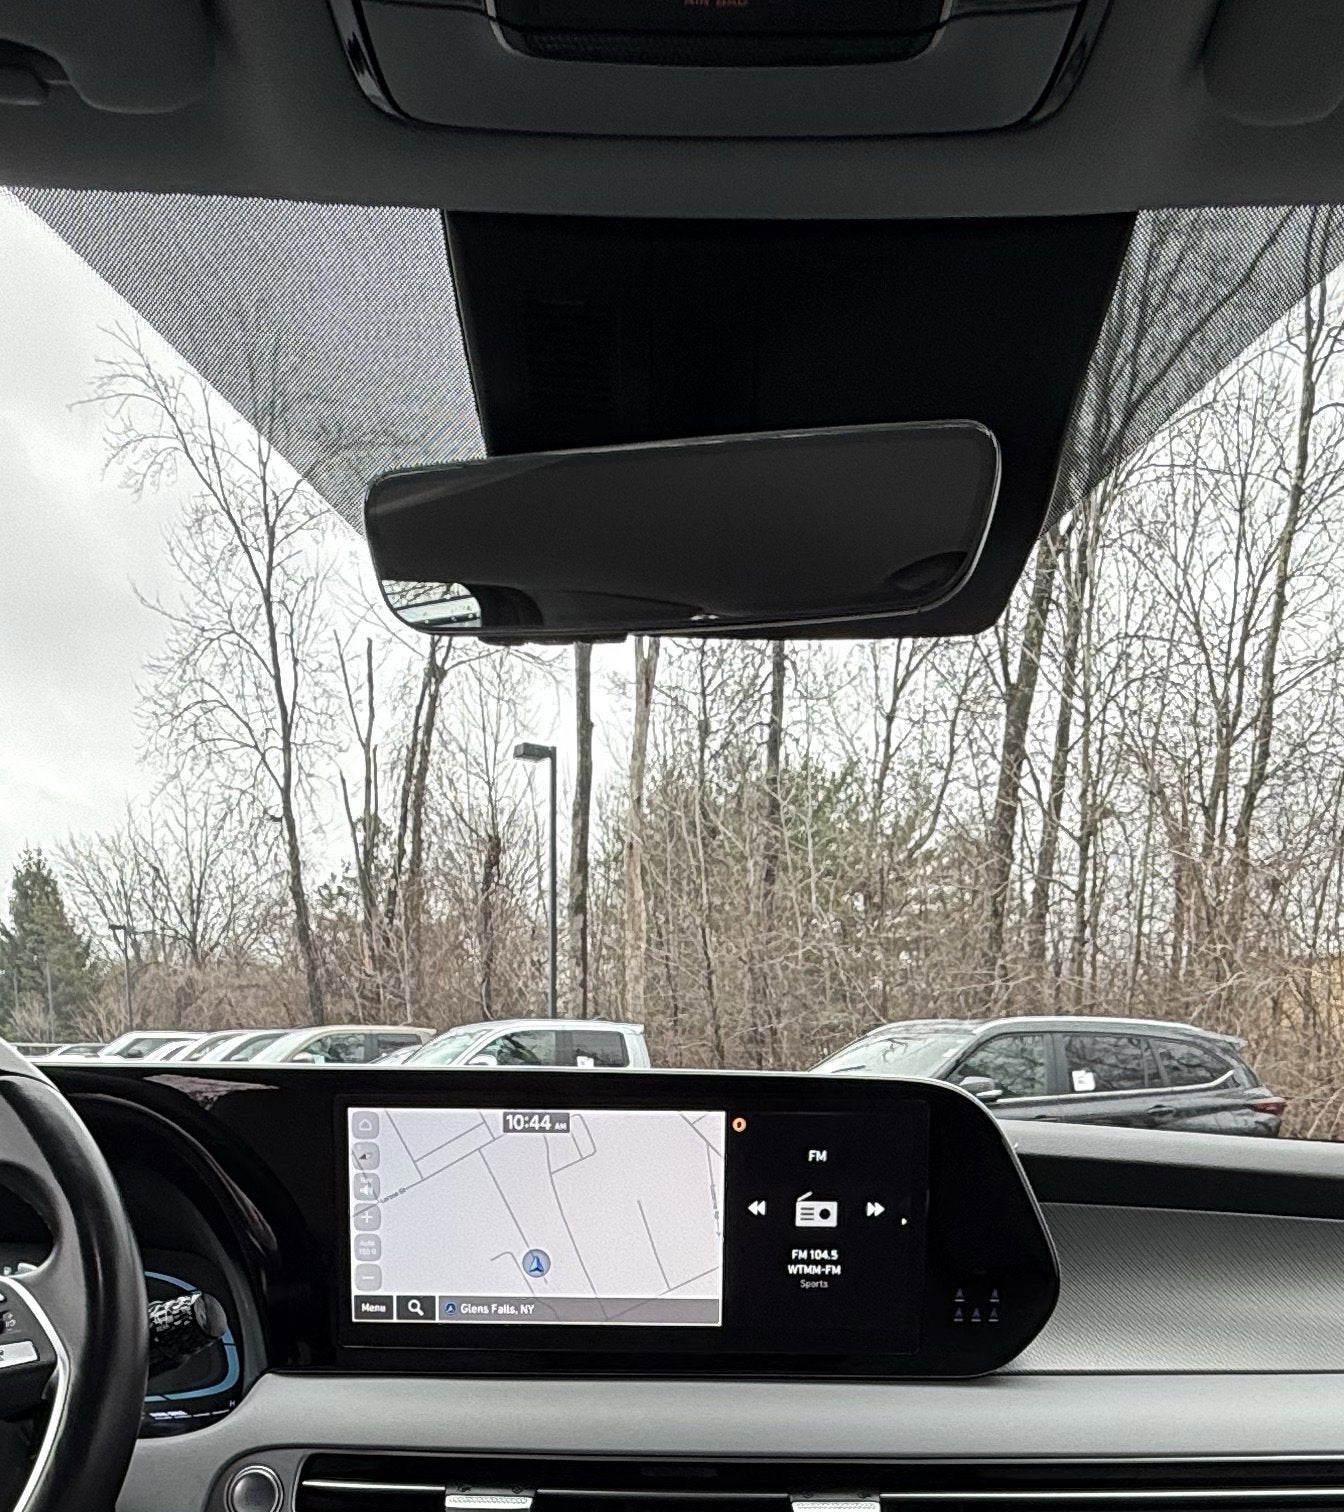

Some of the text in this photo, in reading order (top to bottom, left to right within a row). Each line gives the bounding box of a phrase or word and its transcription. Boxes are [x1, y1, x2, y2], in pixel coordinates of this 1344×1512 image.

[506, 1114, 552, 1131] 10:44
[808, 1149, 828, 1162] FM
[792, 1249, 839, 1260] FM 104.5
[787, 1264, 842, 1275] WTMM-FM
[800, 1279, 829, 1289] Sports
[361, 1303, 386, 1313] Menu
[460, 1303, 535, 1315] Glens Falls, NY
